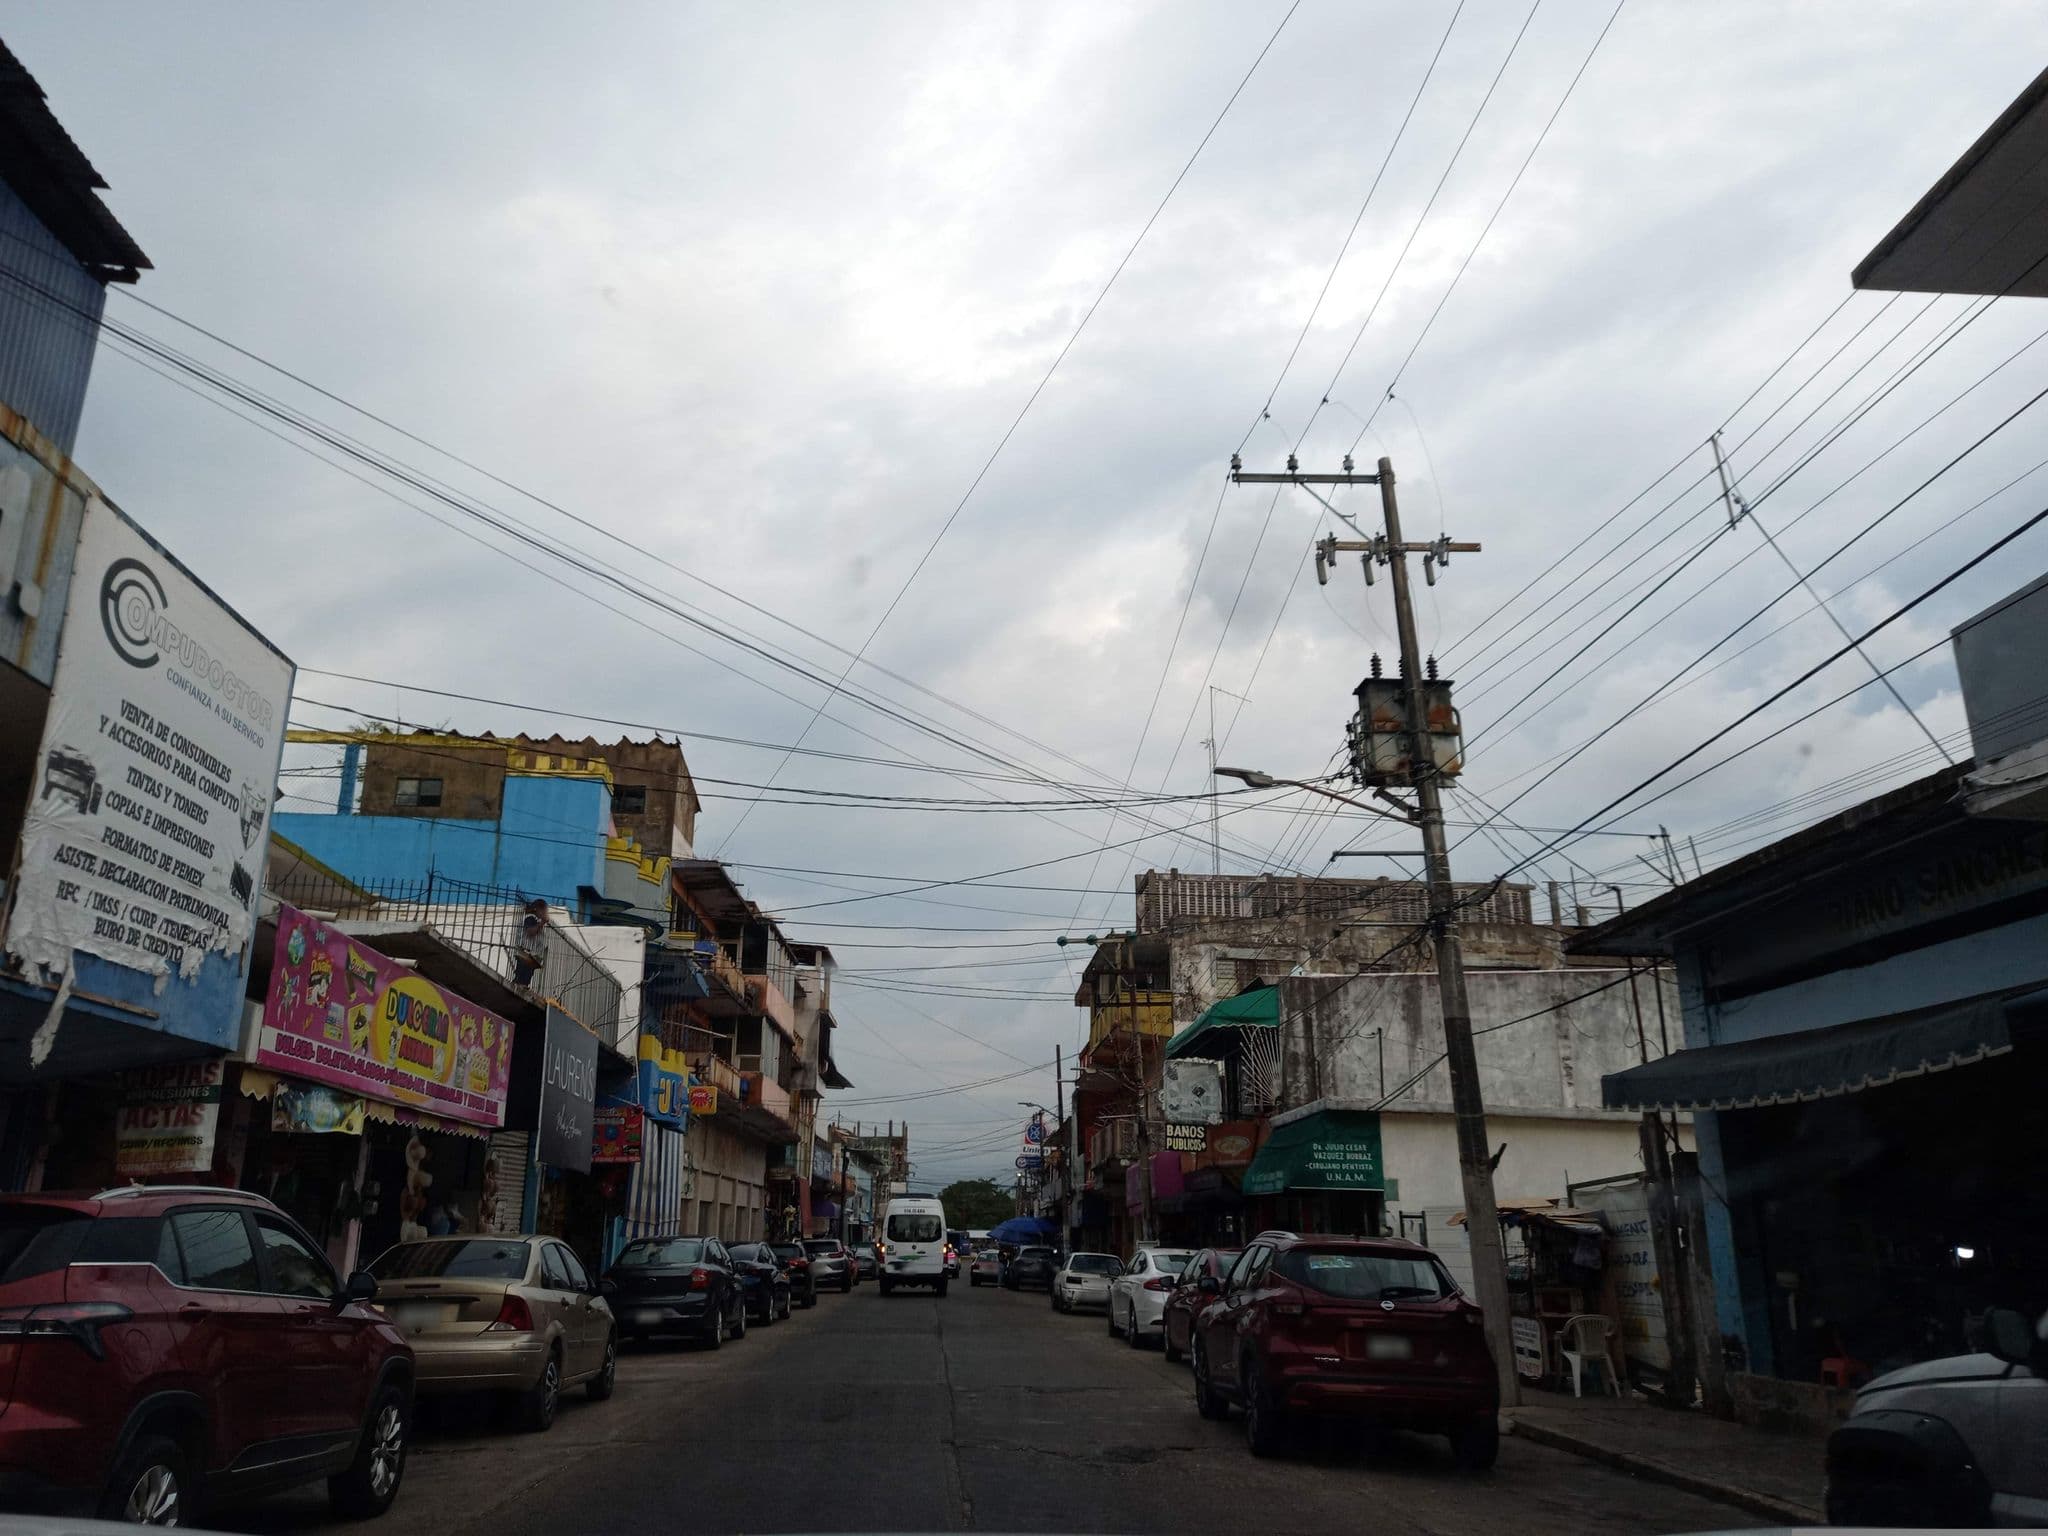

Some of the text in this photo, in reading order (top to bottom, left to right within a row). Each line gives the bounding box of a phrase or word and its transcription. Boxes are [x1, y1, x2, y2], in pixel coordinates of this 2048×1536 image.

[166, 668, 265, 749] CONFIANZA A SU SERVICIO
[98, 714, 240, 813] Y ACCESORIOS PARA COMPUTO
[120, 699, 232, 783] VENTA DE CONSUMIBLES
[105, 791, 215, 859] COPIAS E IMPRESIONES
[126, 766, 209, 825] TINTAS Y TONERS
[53, 843, 230, 930] ASISTE, DECLARACION PATRIMONIAL
[101, 826, 205, 888] FORMATOS DE PEMEX
[56, 880, 80, 904] RFC
[130, 906, 157, 929] CURP
[94, 917, 125, 942] BURO
[125, 927, 142, 945] DE
[547, 1042, 595, 1103] LAUREN'S
[124, 1103, 207, 1130] ACTAS
